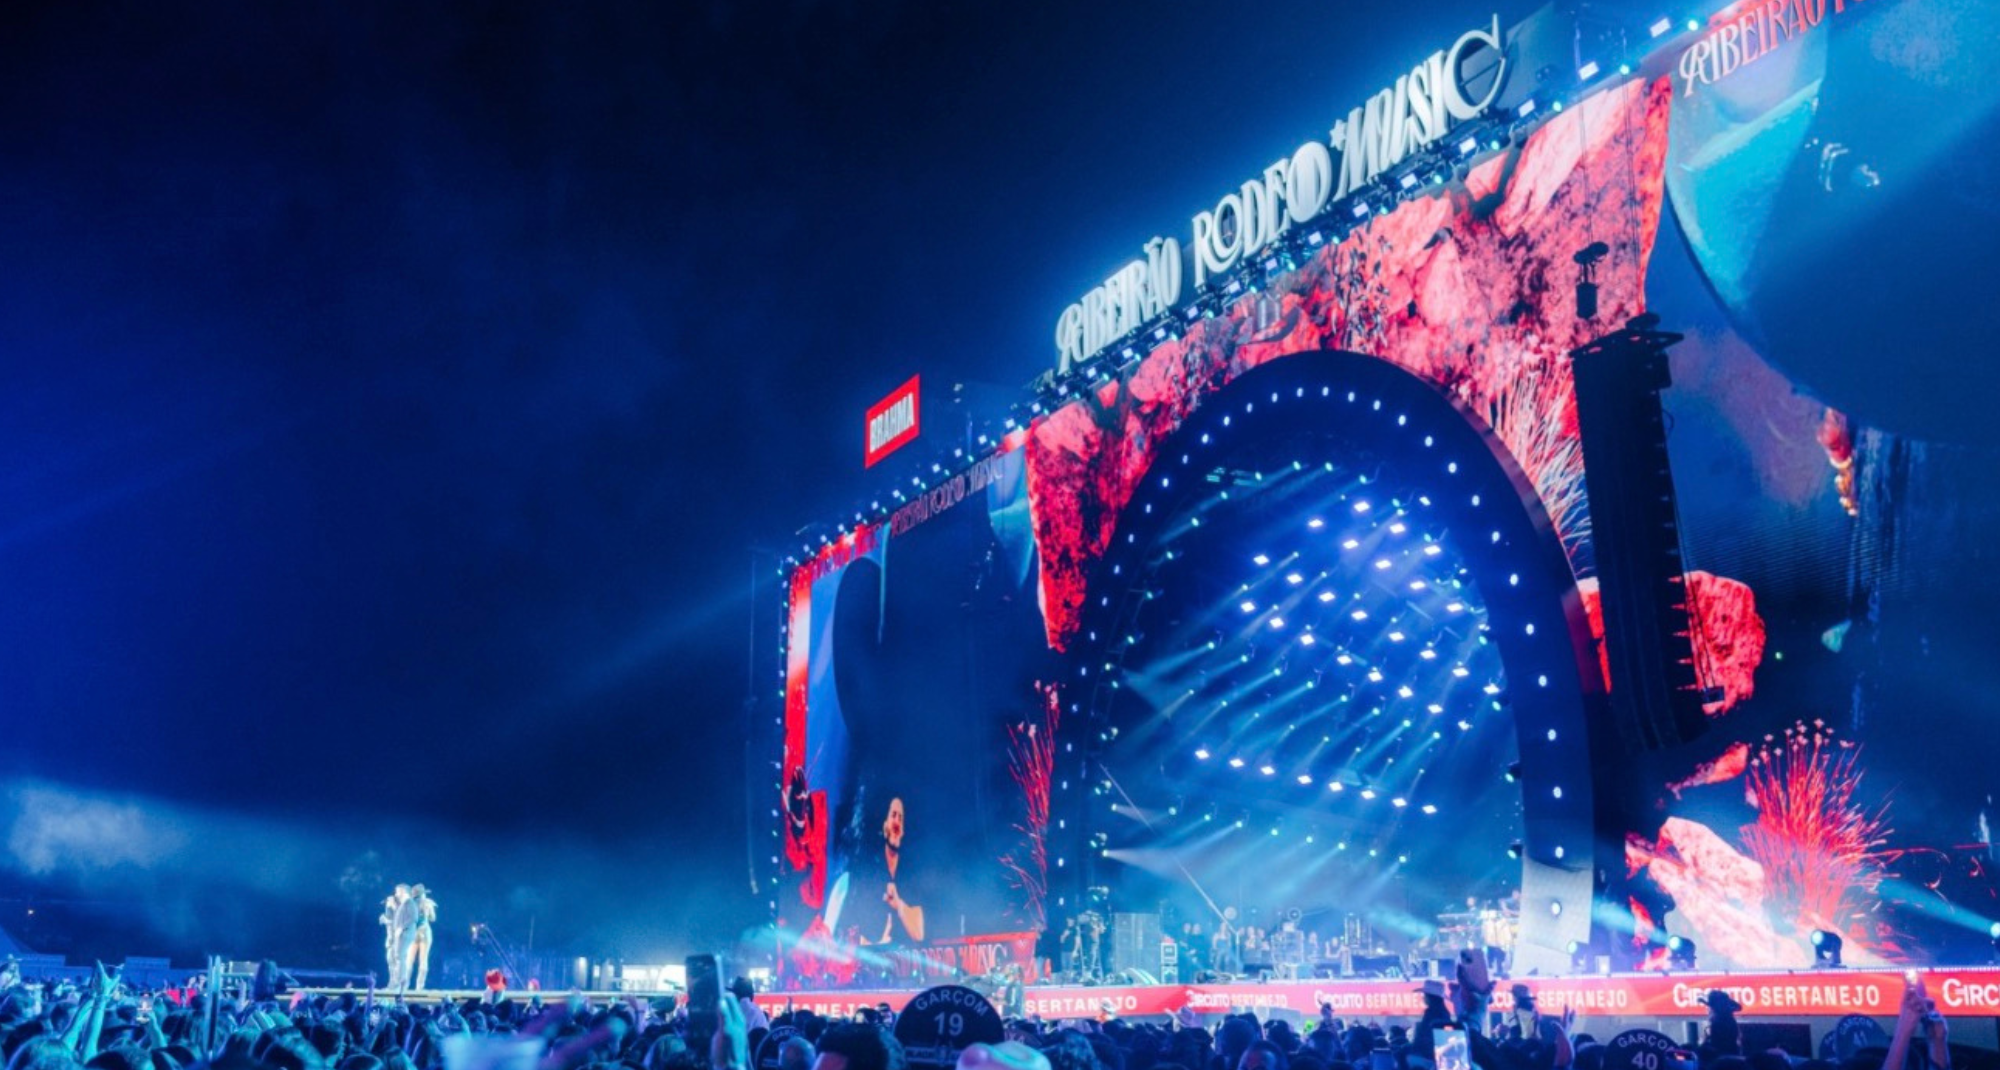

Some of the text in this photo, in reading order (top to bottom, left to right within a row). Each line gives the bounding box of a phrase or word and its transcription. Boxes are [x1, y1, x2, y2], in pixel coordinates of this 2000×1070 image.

[1056, 13, 1506, 374] RIBEIRÃO RODEO MUSIC
[915, 988, 989, 1017] GARÇOM
[1538, 989, 1628, 1008] SERTANEJO
[1760, 984, 1880, 1006] SERTANEJO
[1942, 978, 2000, 1008] CIRC
[934, 1011, 964, 1037] 19
[1631, 1051, 1659, 1070] 40
